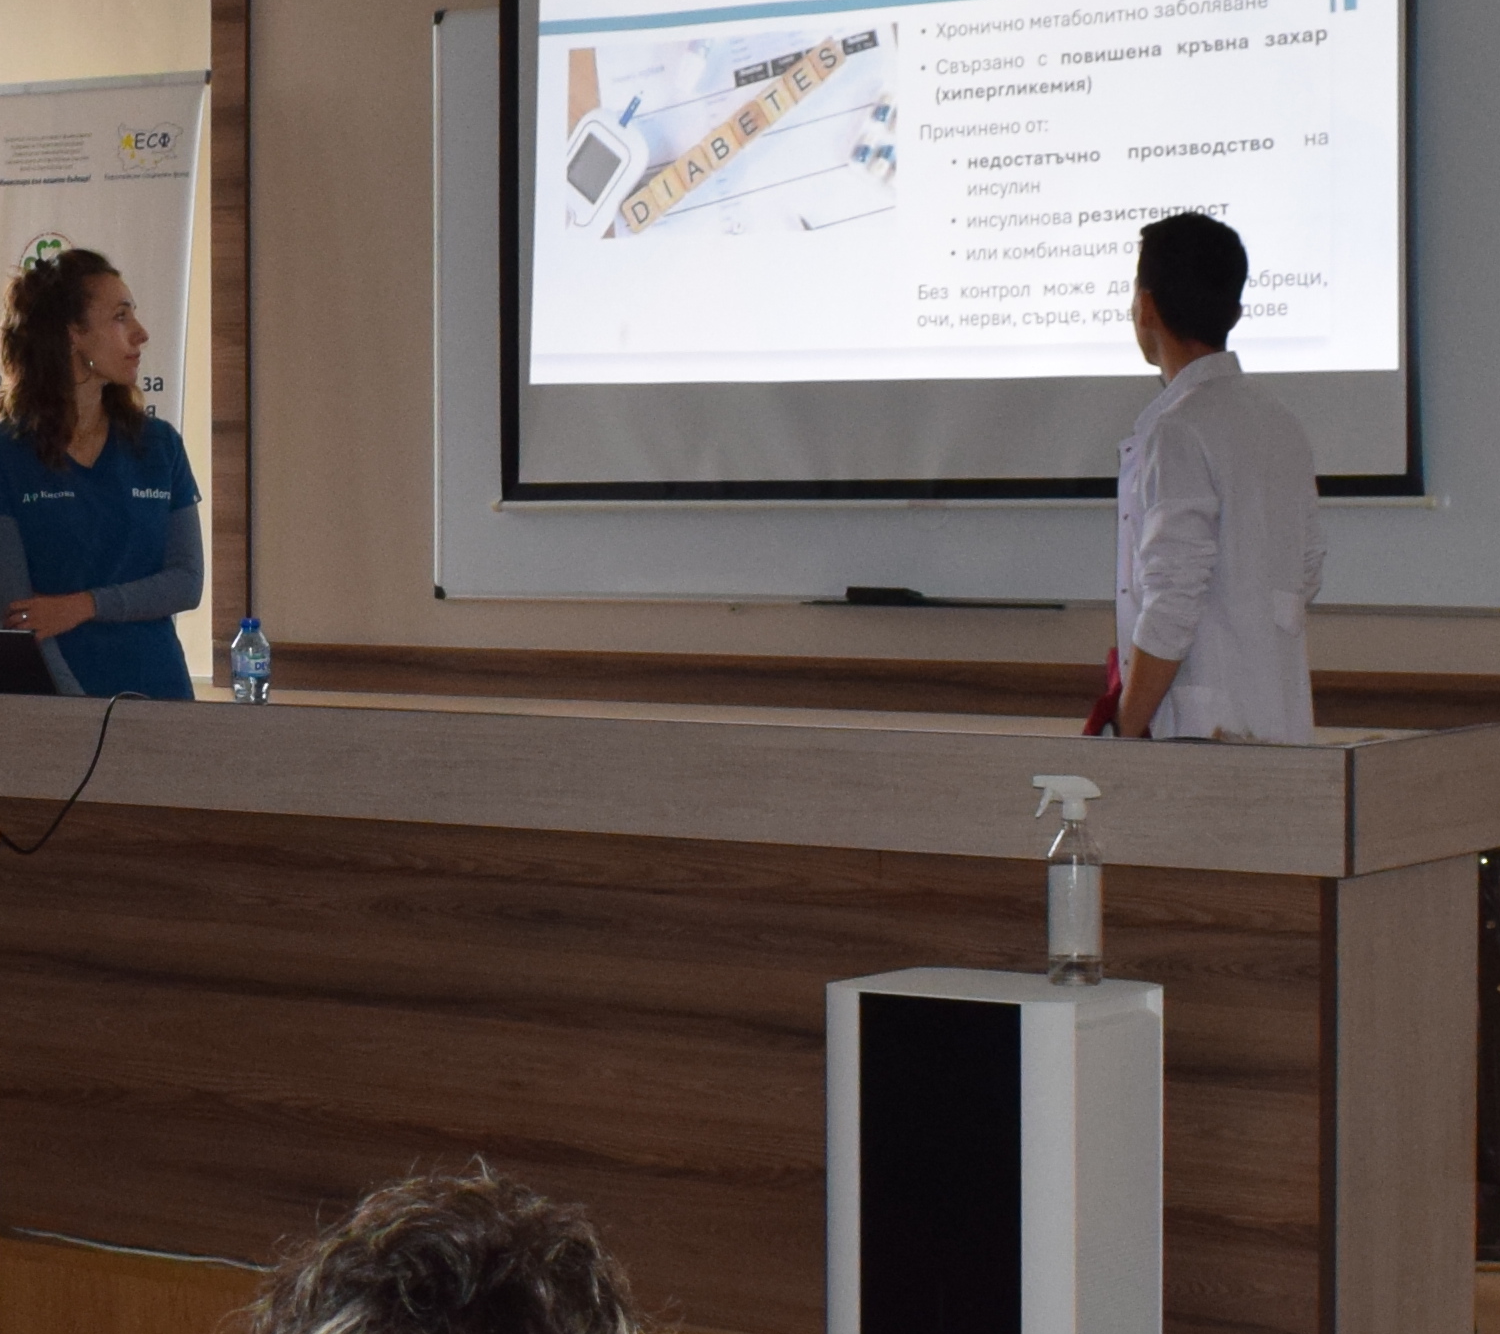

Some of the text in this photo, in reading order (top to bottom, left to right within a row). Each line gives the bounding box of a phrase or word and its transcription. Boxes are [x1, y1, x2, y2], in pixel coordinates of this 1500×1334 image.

[935, 17, 1025, 40] Хронично
[1029, 7, 1149, 29] метаболитно
[936, 28, 1328, 75] Свързано с повишена кръвна захар
[935, 75, 1093, 105] (хипергликемия)
[630, 46, 838, 225] DIABETES
[919, 119, 1049, 143] Причинено от:
[967, 131, 1329, 170] недостатъчно производство на
[967, 180, 1041, 199] инсулин
[966, 211, 1073, 231] инсулинова
[966, 247, 998, 261] или
[1002, 241, 1118, 259] комбинация
[918, 269, 1328, 302] Без контрол може да ъбреци,
[917, 314, 954, 328] очи,
[959, 312, 1017, 329] нерви,
[1022, 309, 1086, 327] сърце,
[142, 376, 164, 392] за
